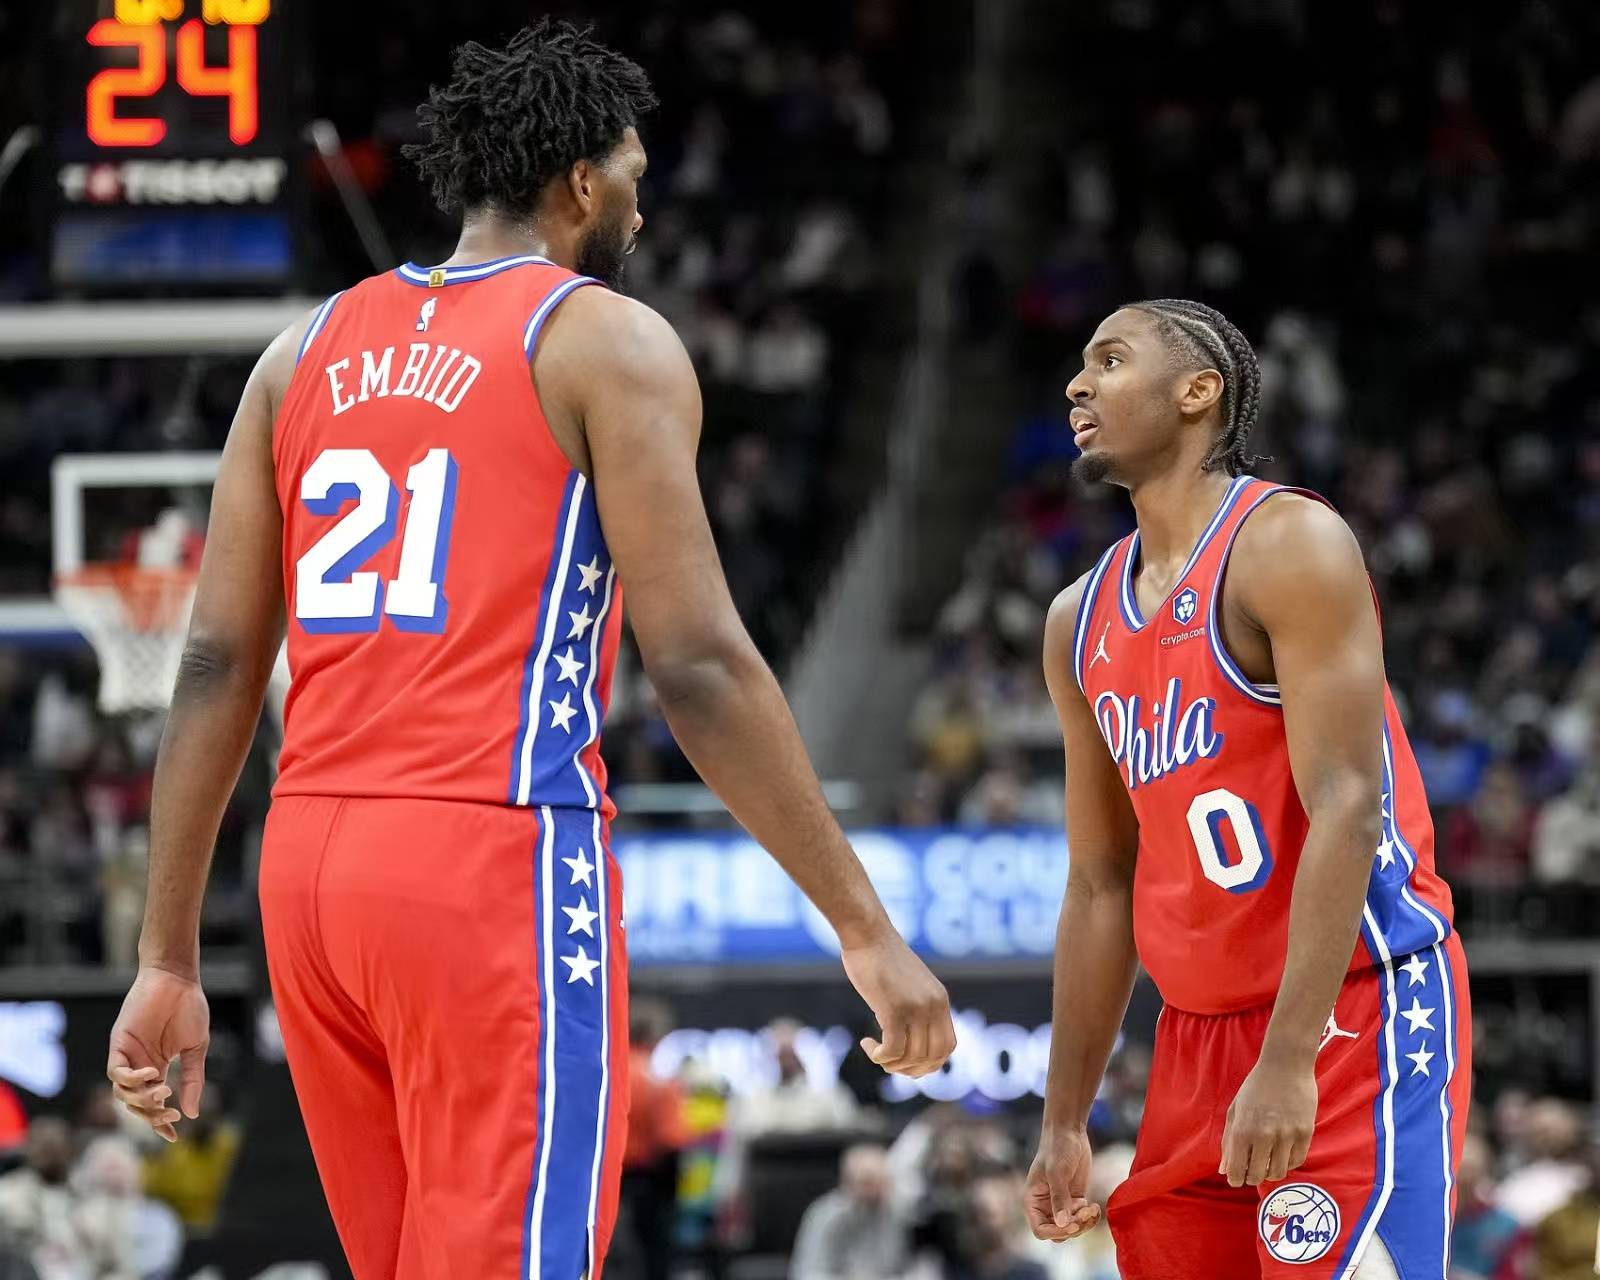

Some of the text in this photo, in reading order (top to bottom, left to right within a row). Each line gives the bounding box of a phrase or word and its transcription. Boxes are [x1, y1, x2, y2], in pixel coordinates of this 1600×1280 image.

[86, 18, 258, 146] 24
[325, 343, 481, 416] EMBIID
[296, 448, 459, 634] 21
[1094, 677, 1224, 790] Phila
[1186, 788, 1274, 895] 0
[1268, 1213, 1331, 1244] 76ers
